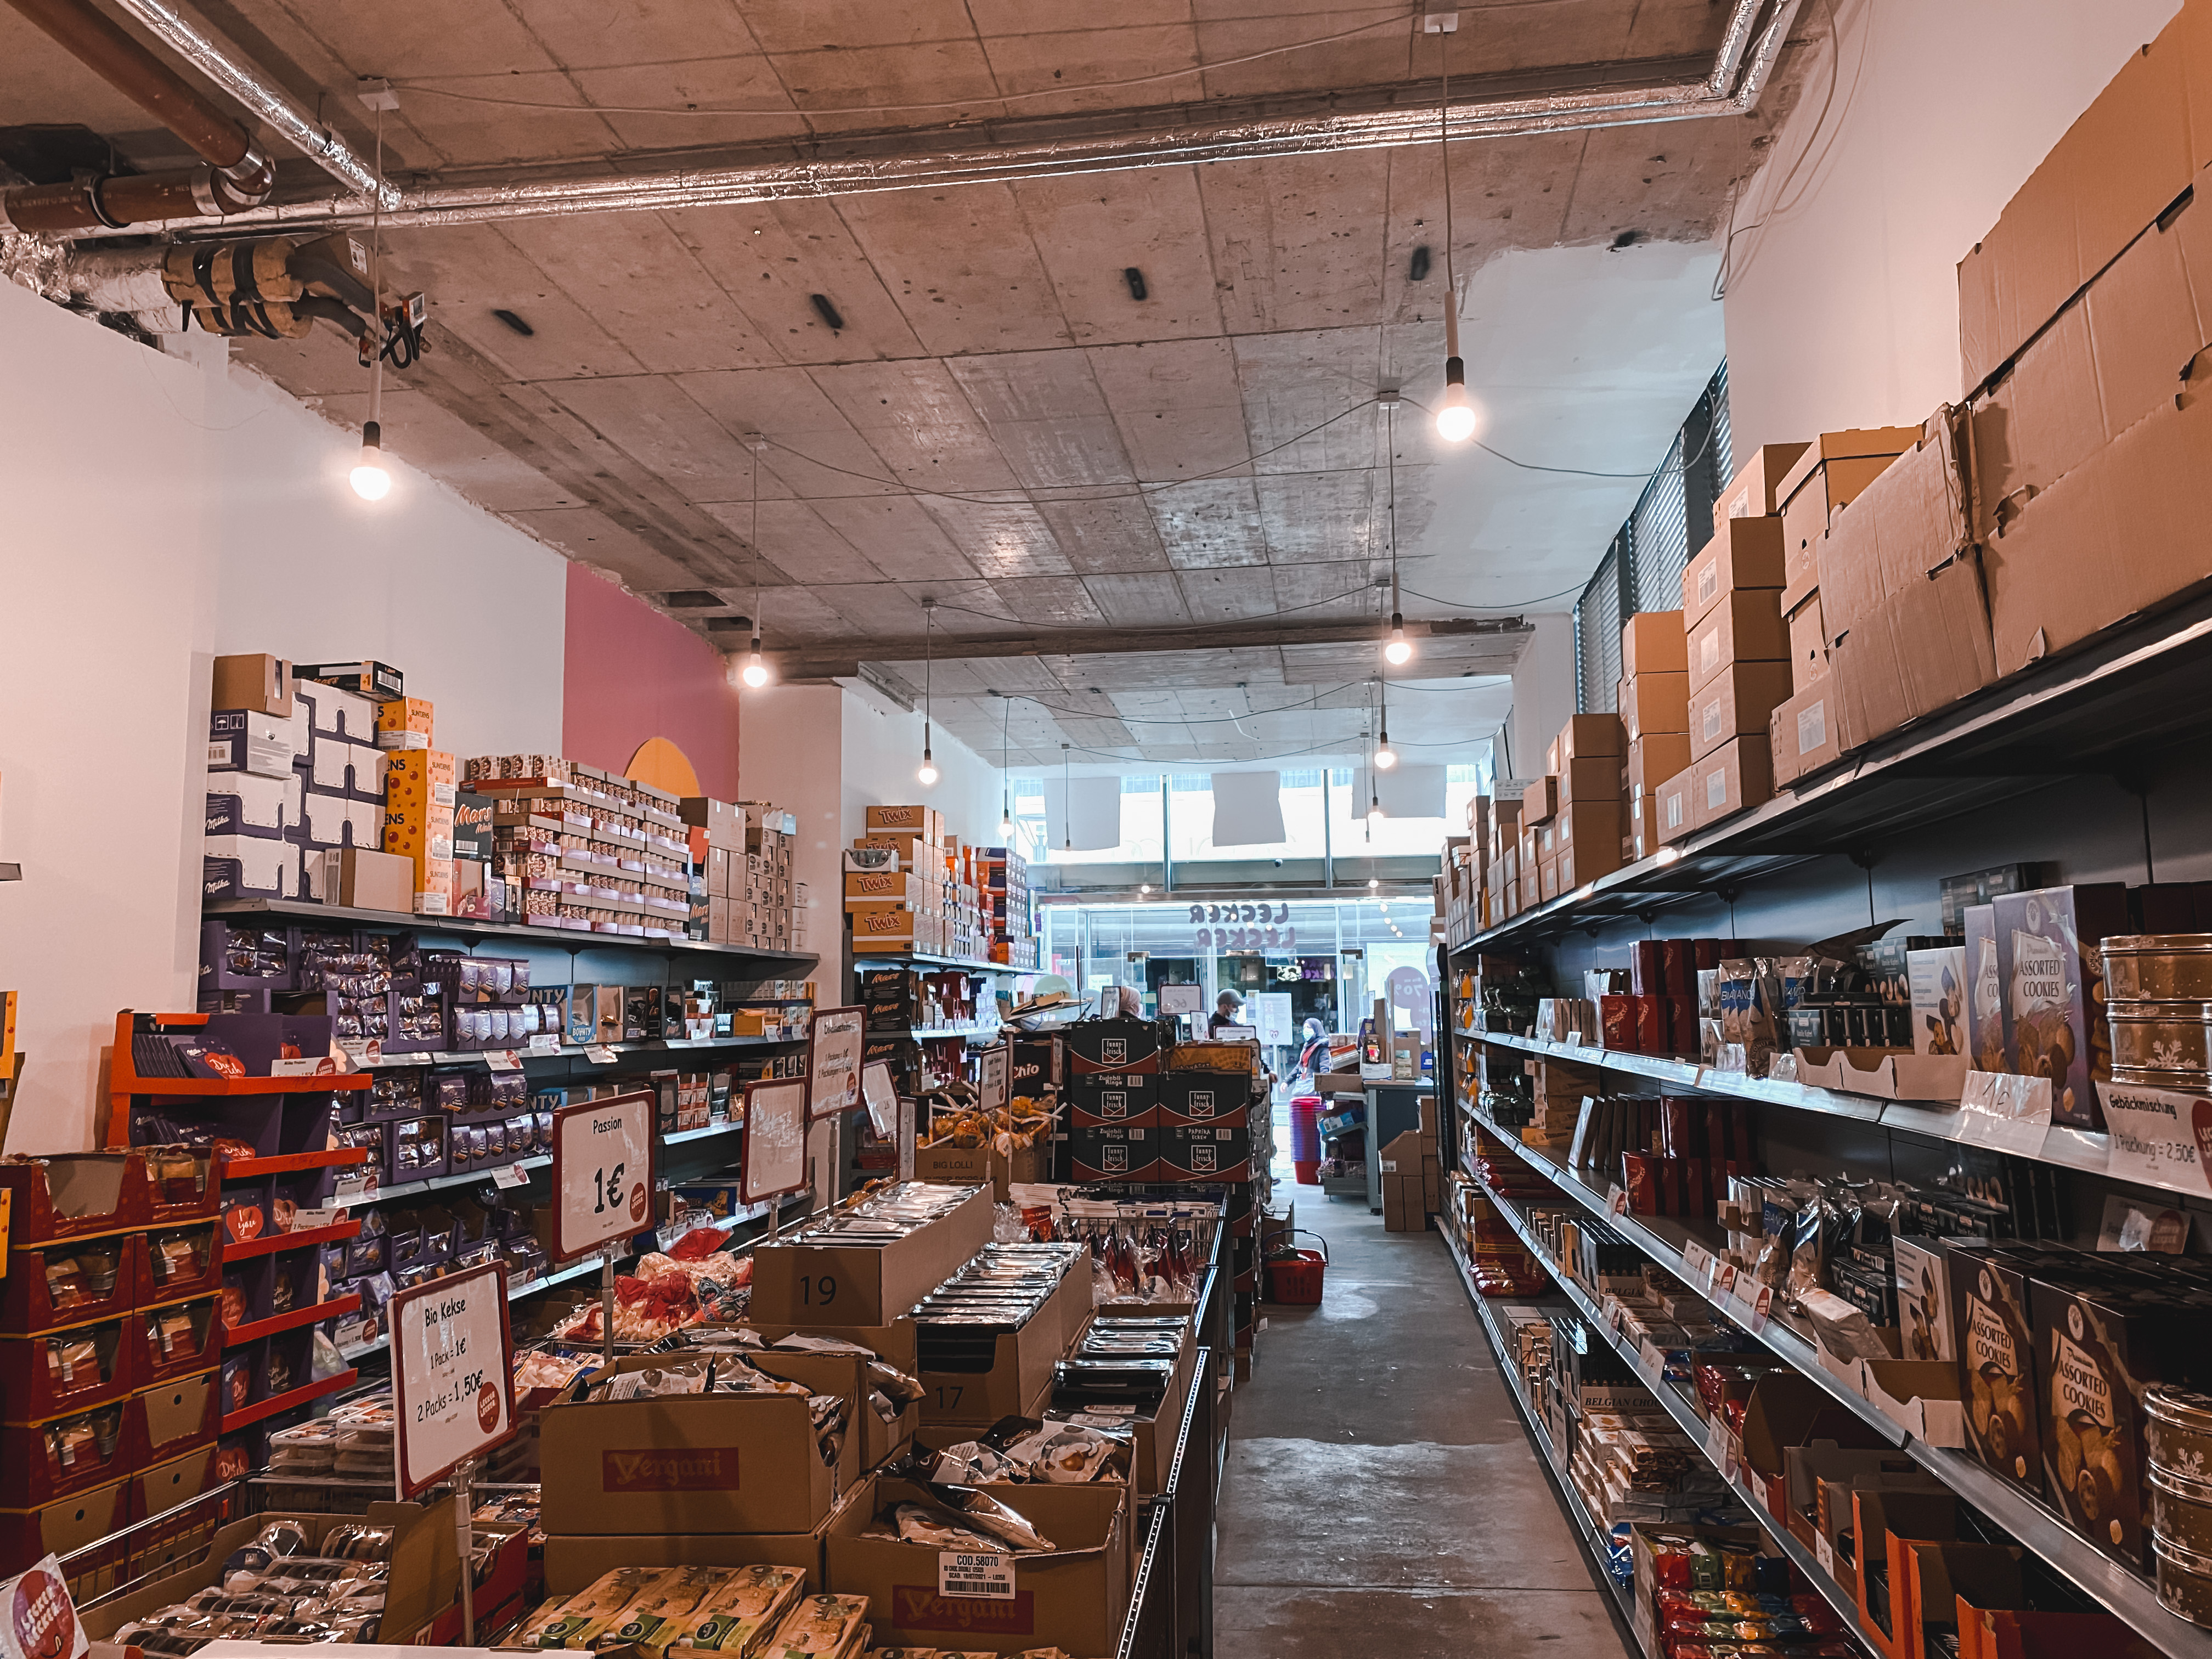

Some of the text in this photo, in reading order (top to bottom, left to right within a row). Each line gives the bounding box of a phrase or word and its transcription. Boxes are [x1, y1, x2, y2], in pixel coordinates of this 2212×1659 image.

[206, 816, 230, 830] Milka
[454, 803, 492, 827] Mars
[878, 808, 913, 823] Twix
[205, 879, 230, 893] Milka
[857, 874, 894, 893] Twix
[864, 913, 901, 932] Twix
[2019, 961, 2060, 976] ASSORTED
[872, 973, 900, 984] Mars
[2023, 981, 2059, 997] COOKIES
[872, 1002, 899, 1014] Mars
[572, 1028, 591, 1036] BOUNTY
[867, 1044, 895, 1055] Mars
[2109, 1094, 2177, 1120] Gebäckmischung
[593, 1116, 622, 1135] Passion
[2166, 1143, 2195, 1164] 2,50€
[594, 1163, 625, 1214] 1€
[238, 1220, 257, 1236] you
[799, 1276, 837, 1306] 19
[425, 1297, 466, 1328] Bio Kekse
[1973, 1320, 2011, 1349] ASSORTED
[435, 1348, 449, 1367] Pack
[455, 1336, 466, 1357] 1€
[1976, 1340, 2011, 1369] COOKIES
[2058, 1360, 2107, 1397] ASSORTED
[417, 1404, 424, 1423] 2
[425, 1391, 447, 1415] Packs
[455, 1369, 483, 1403] 1,50€
[936, 1386, 964, 1410] 17
[1585, 1397, 1628, 1407] BELGIAN
[2063, 1384, 2106, 1419] COOKIES
[608, 1451, 722, 1486] Vergani
[957, 1555, 998, 1567] COD.58070
